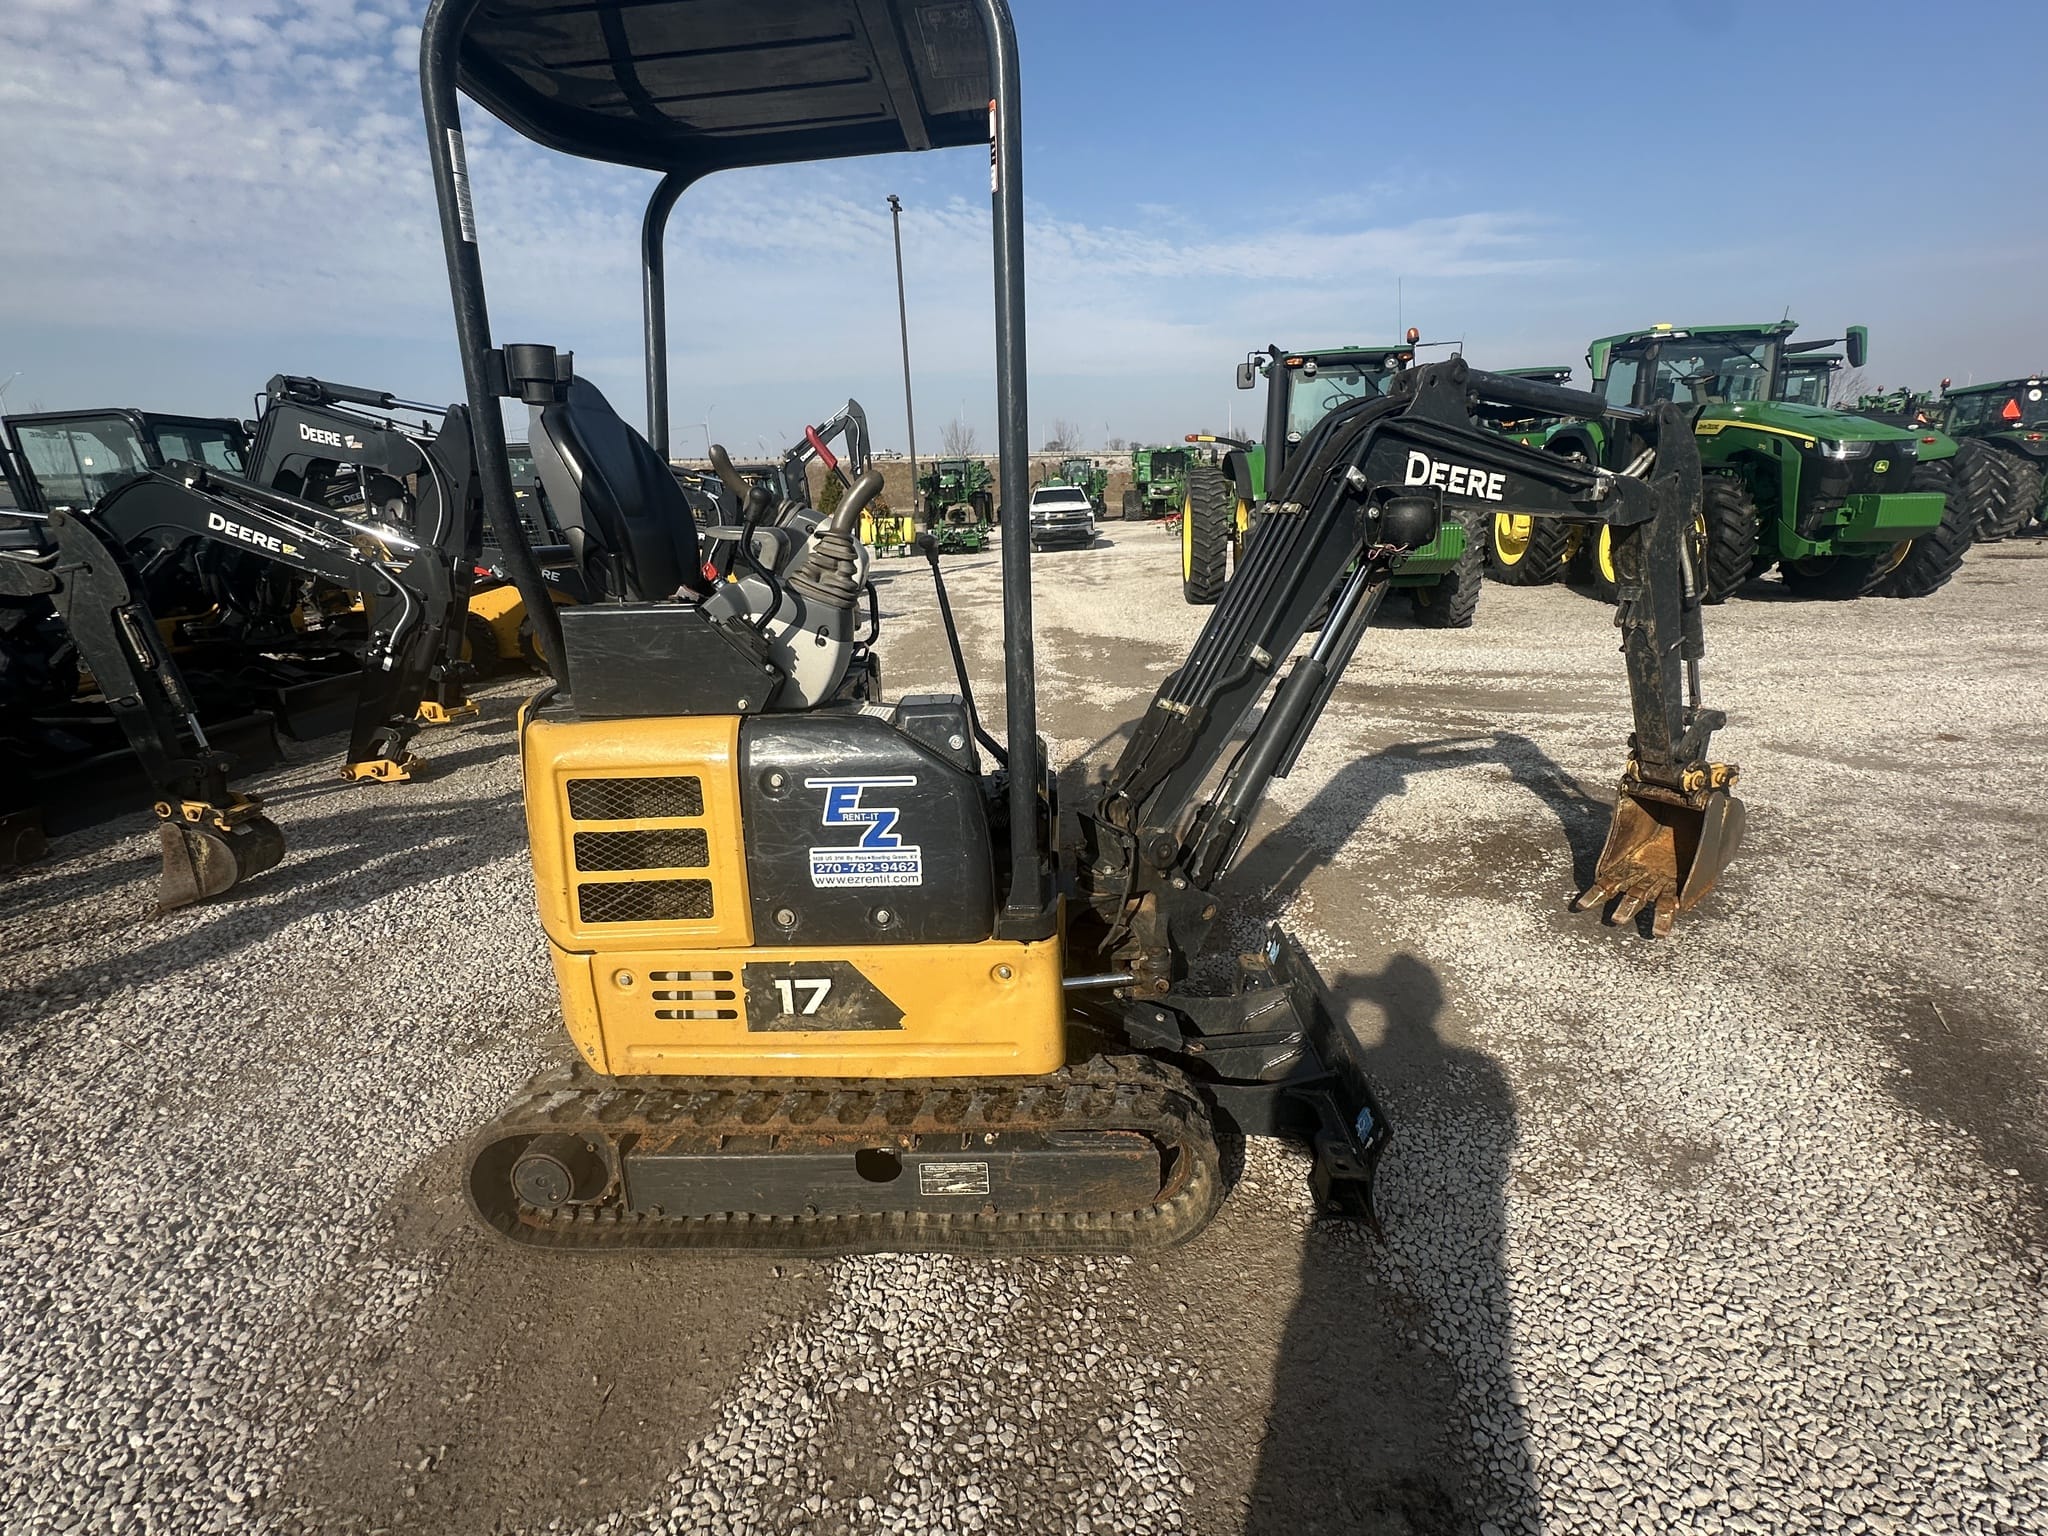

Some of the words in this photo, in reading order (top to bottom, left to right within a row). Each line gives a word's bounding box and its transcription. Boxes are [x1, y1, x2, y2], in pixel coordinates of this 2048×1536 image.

[299, 423, 342, 448] DEERE
[1404, 450, 1506, 501] DEERE
[207, 512, 282, 553] DEERE
[842, 812, 879, 821] RENT-IT
[815, 875, 919, 885] www.ezrentit.com
[816, 862, 916, 873] 270-782-9462
[775, 978, 832, 1015] 17
